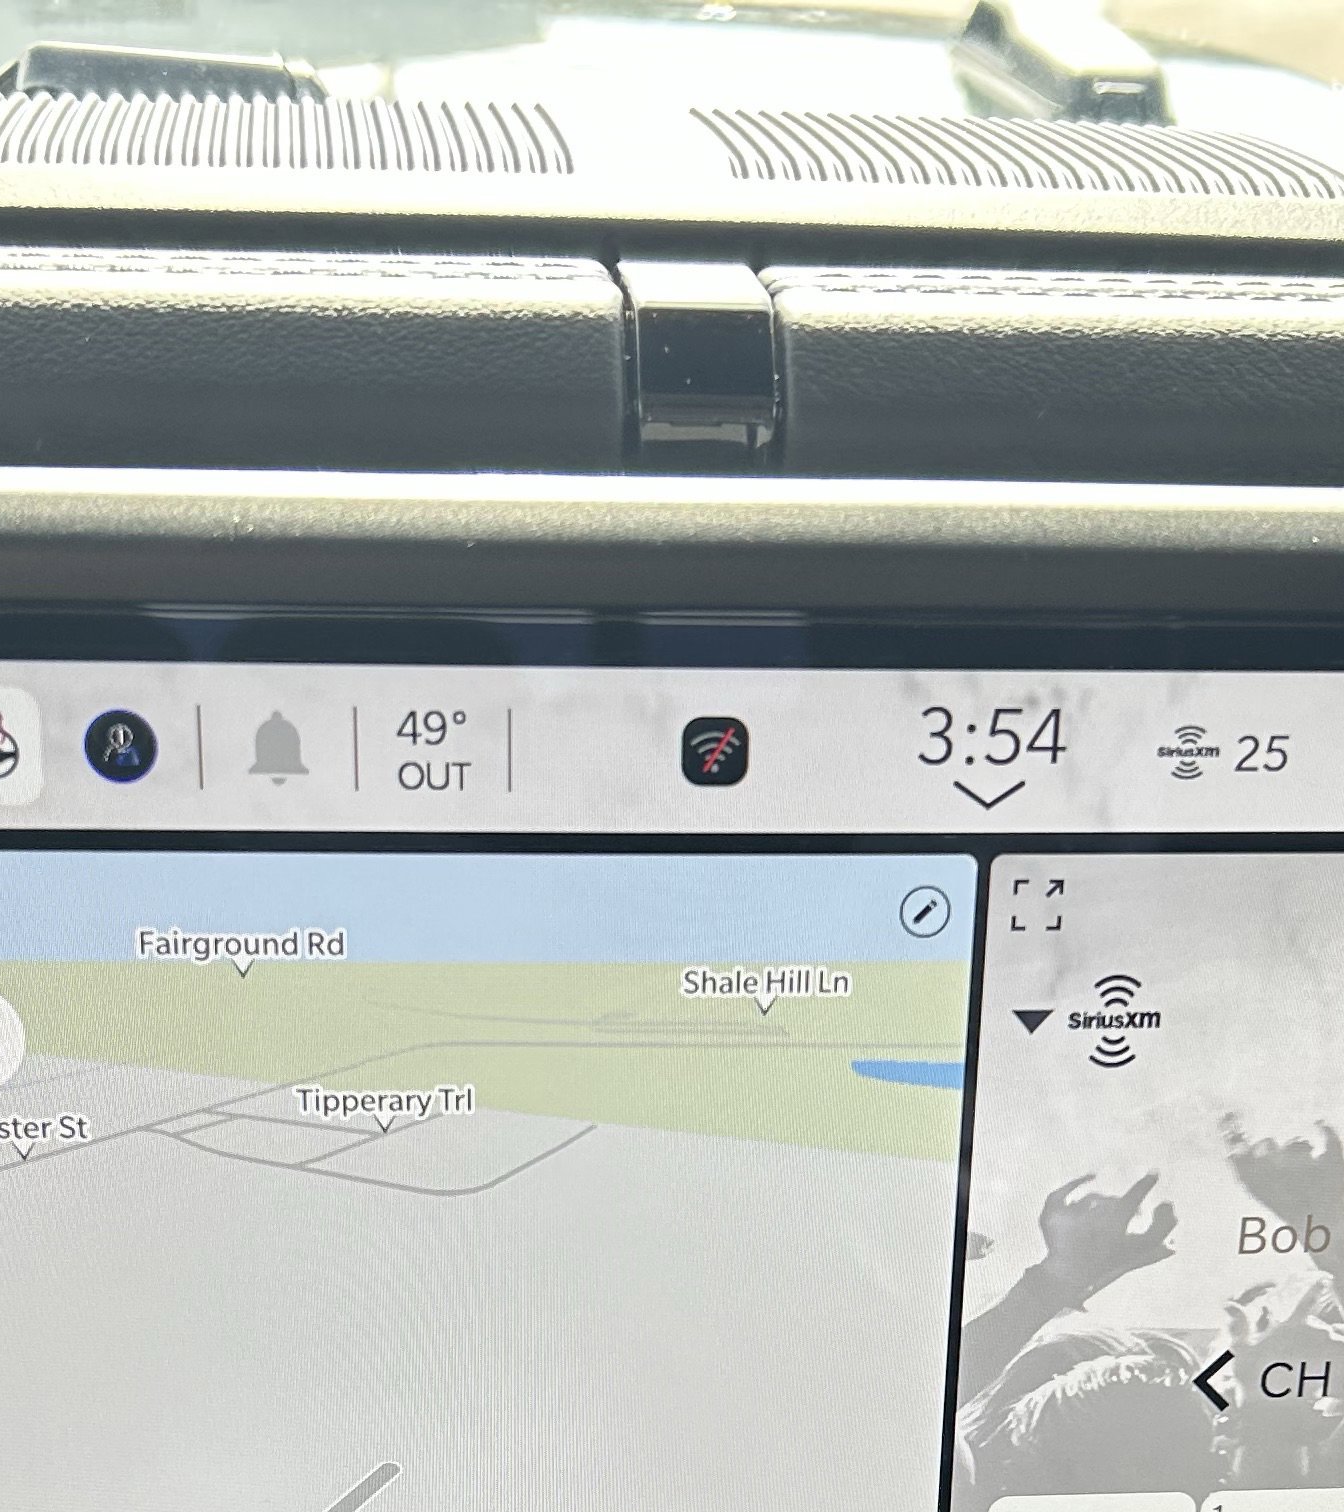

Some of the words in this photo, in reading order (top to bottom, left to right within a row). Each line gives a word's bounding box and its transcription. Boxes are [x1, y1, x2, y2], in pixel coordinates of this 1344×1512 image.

[396, 710, 467, 746] 49°
[917, 706, 1067, 765] 3:54
[1234, 735, 1290, 772] 25
[397, 762, 472, 792] OUT
[139, 930, 299, 962] Fairground
[305, 930, 346, 958] Rd
[683, 968, 758, 995] Shale
[764, 968, 812, 995] Hill
[818, 969, 850, 995] Ln
[296, 1086, 432, 1120] Tipperary
[439, 1086, 473, 1113] Trl
[54, 1115, 87, 1142] St
[1238, 1215, 1330, 1255] Bob
[1259, 1360, 1331, 1399] CH
